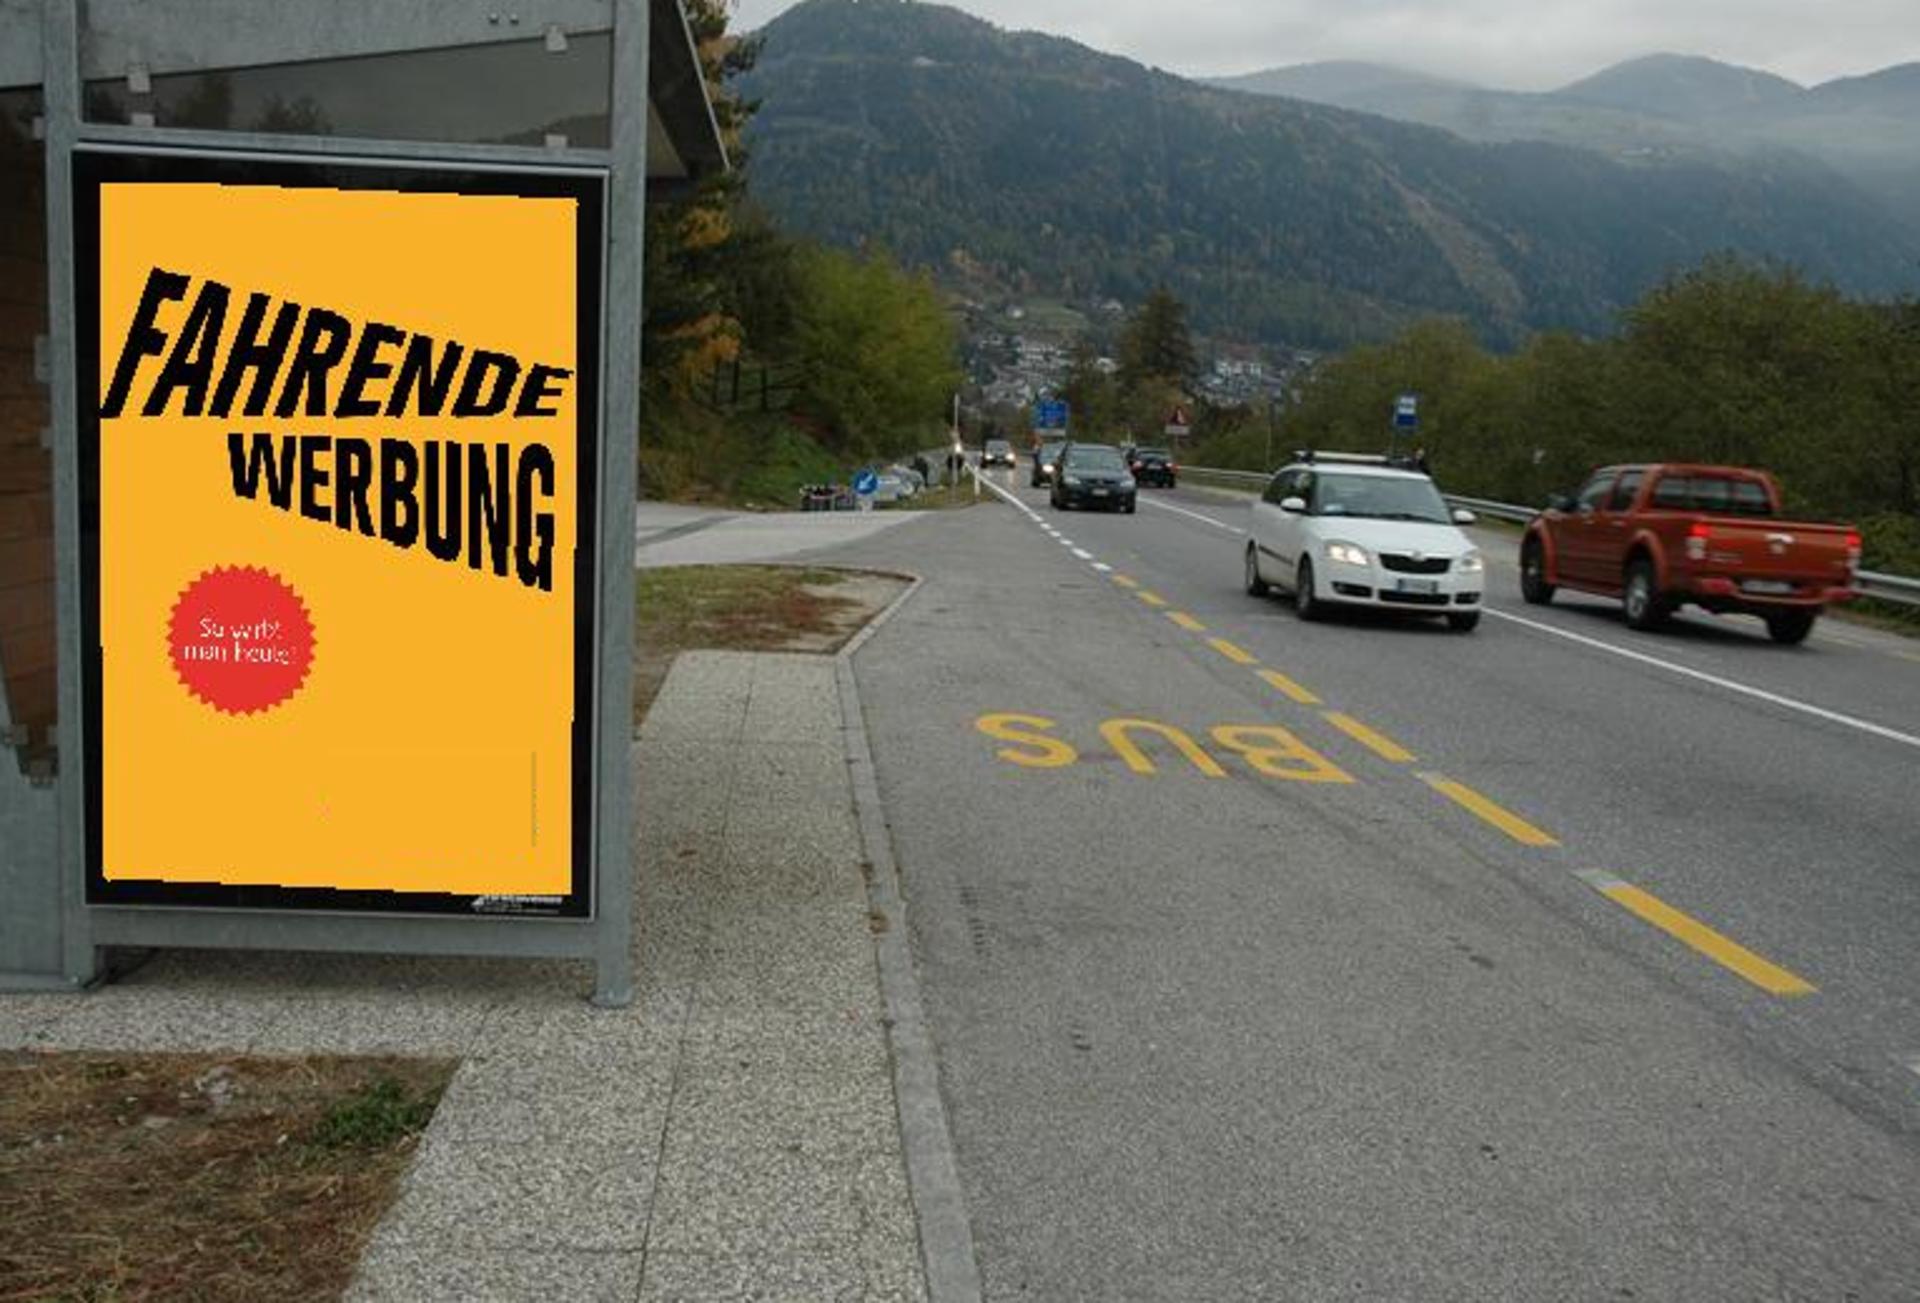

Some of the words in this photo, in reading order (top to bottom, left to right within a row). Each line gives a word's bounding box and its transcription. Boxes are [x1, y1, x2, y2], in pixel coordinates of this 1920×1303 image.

[100, 267, 574, 418] FAHRENDE
[228, 433, 555, 591] WERBUNG
[184, 644, 227, 662] man
[230, 618, 283, 640] wrbt
[974, 712, 1356, 784] BUS
